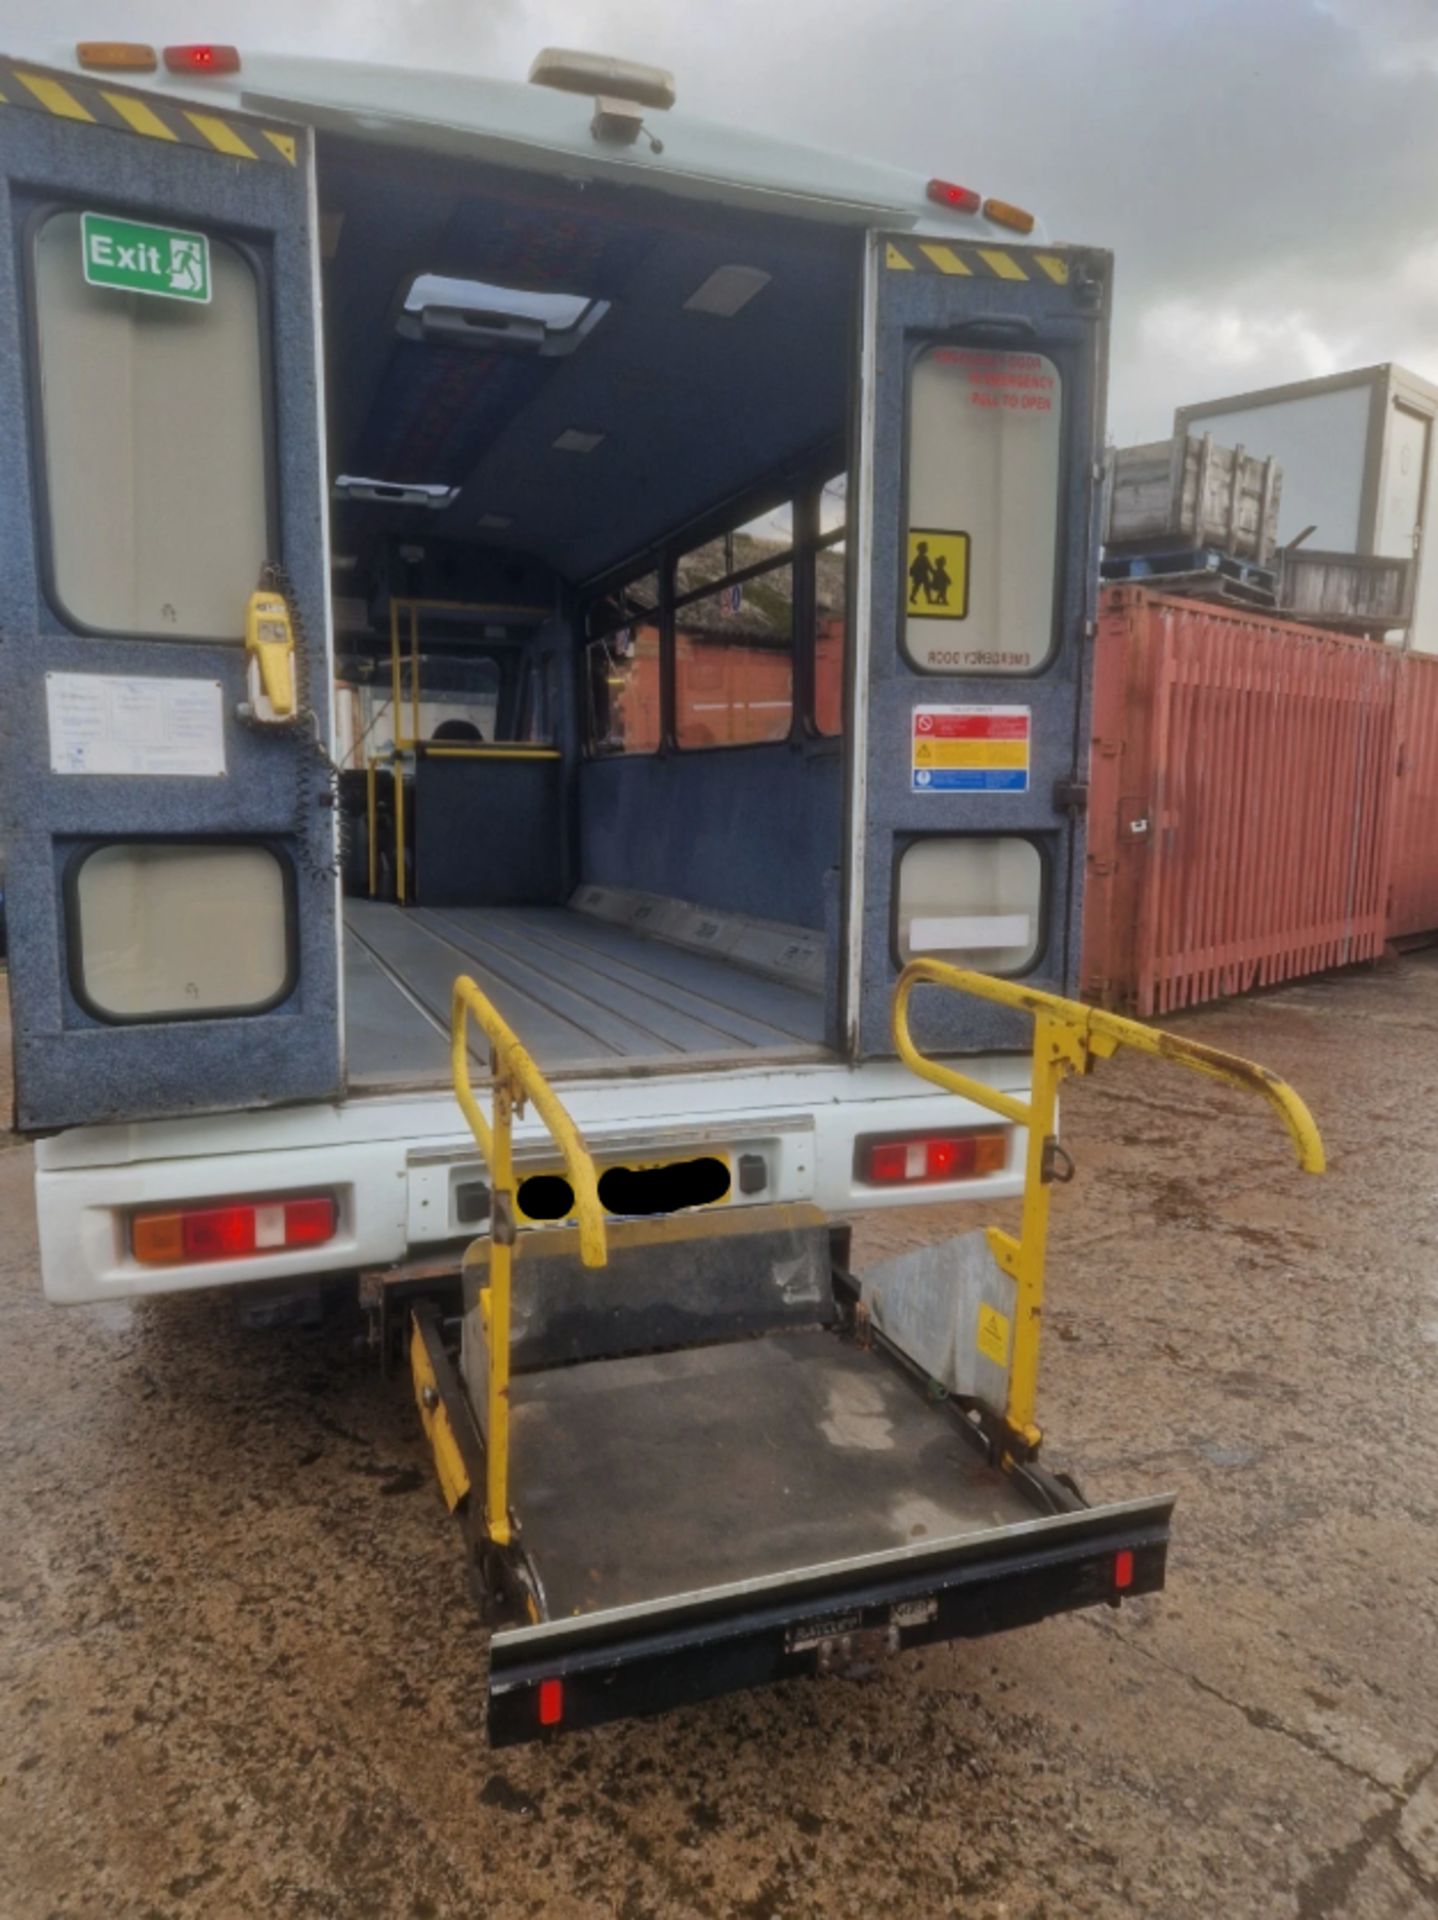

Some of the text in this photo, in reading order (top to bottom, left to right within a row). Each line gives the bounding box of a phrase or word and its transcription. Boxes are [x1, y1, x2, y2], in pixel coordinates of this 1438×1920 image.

[90, 234, 162, 275] Exit
[1002, 394, 1019, 408] TO
[1022, 395, 1052, 411] OPEN
